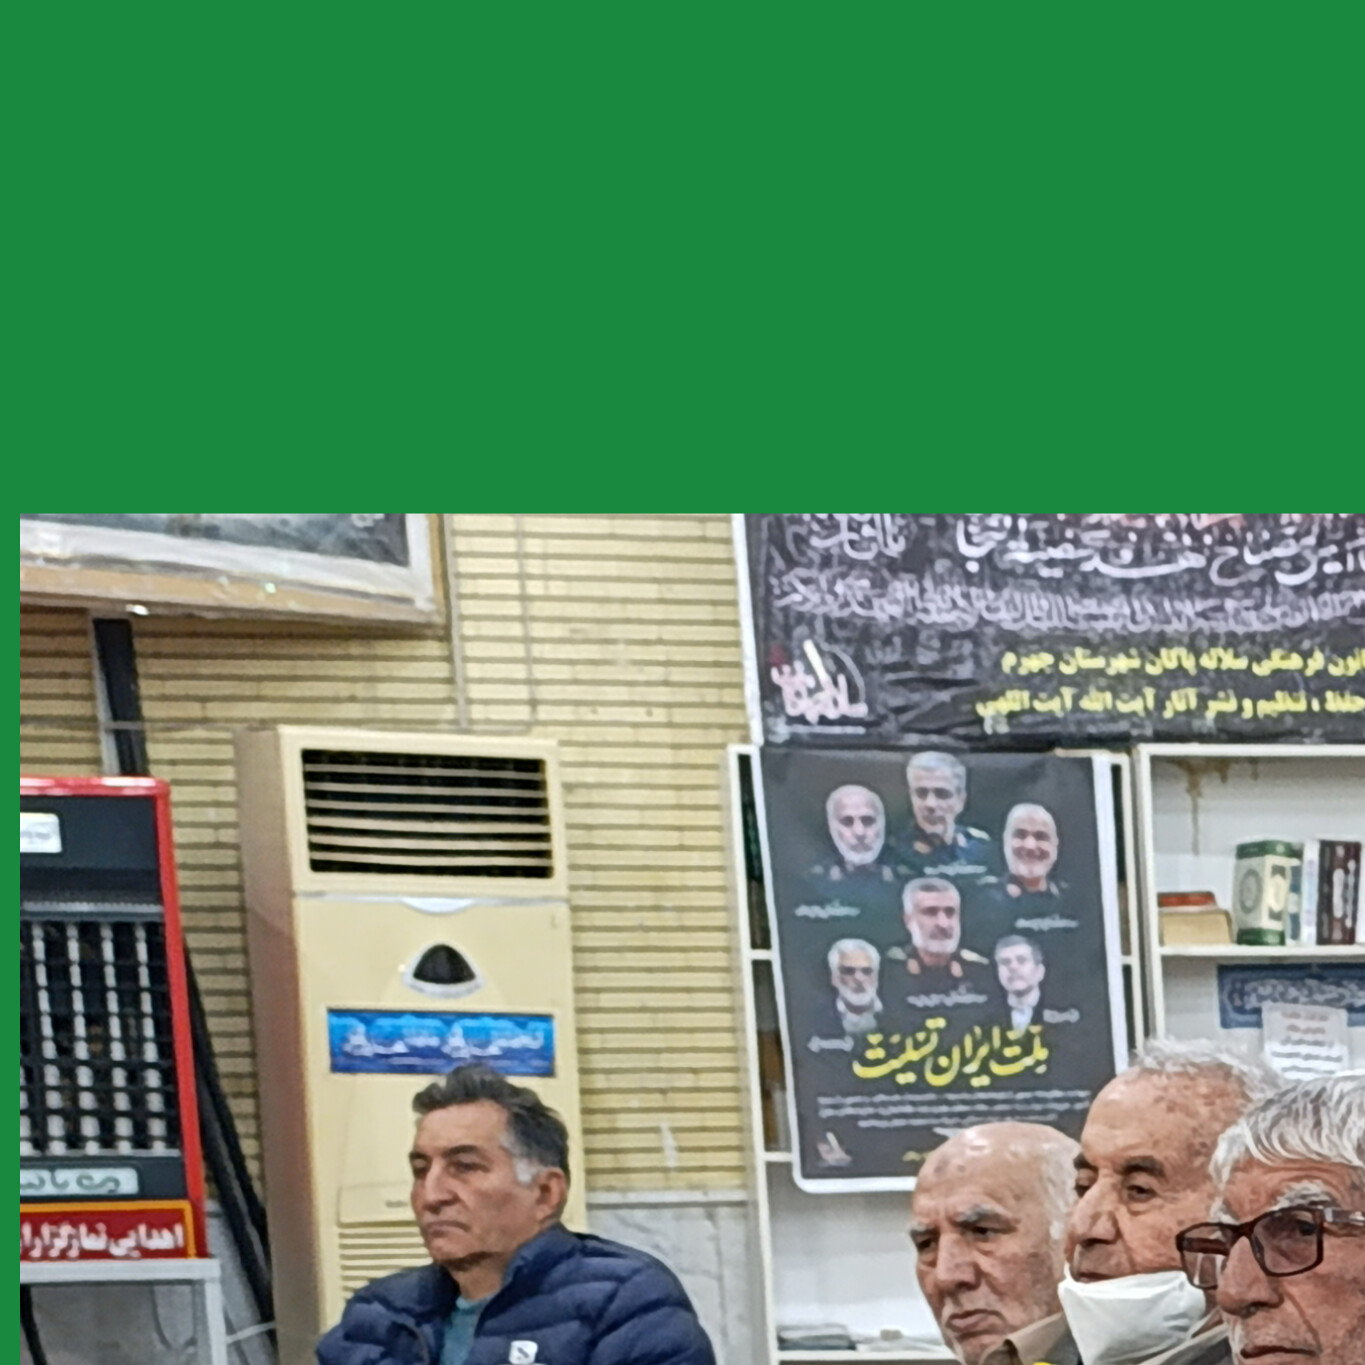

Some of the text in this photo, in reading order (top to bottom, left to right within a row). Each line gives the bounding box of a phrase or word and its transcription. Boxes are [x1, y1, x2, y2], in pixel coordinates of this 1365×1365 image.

[1001, 651, 1056, 676] جهرم
[1058, 646, 1142, 676] شهرستان
[1145, 646, 1197, 676] پاکان
[1199, 647, 1249, 670] سلاله
[1252, 645, 1325, 676] فرهنگی
[1032, 686, 1078, 718] آیت
[1079, 686, 1113, 712] الله
[1115, 686, 1157, 718] آیت
[1162, 686, 1198, 719] آثار
[1205, 689, 1238, 718] نشر
[1241, 697, 1254, 719] و
[1256, 690, 1308, 719] تنظیم
[852, 1017, 1049, 1088] ملت ایران تسلیت
[20, 1221, 108, 1258] نمازگزارا
